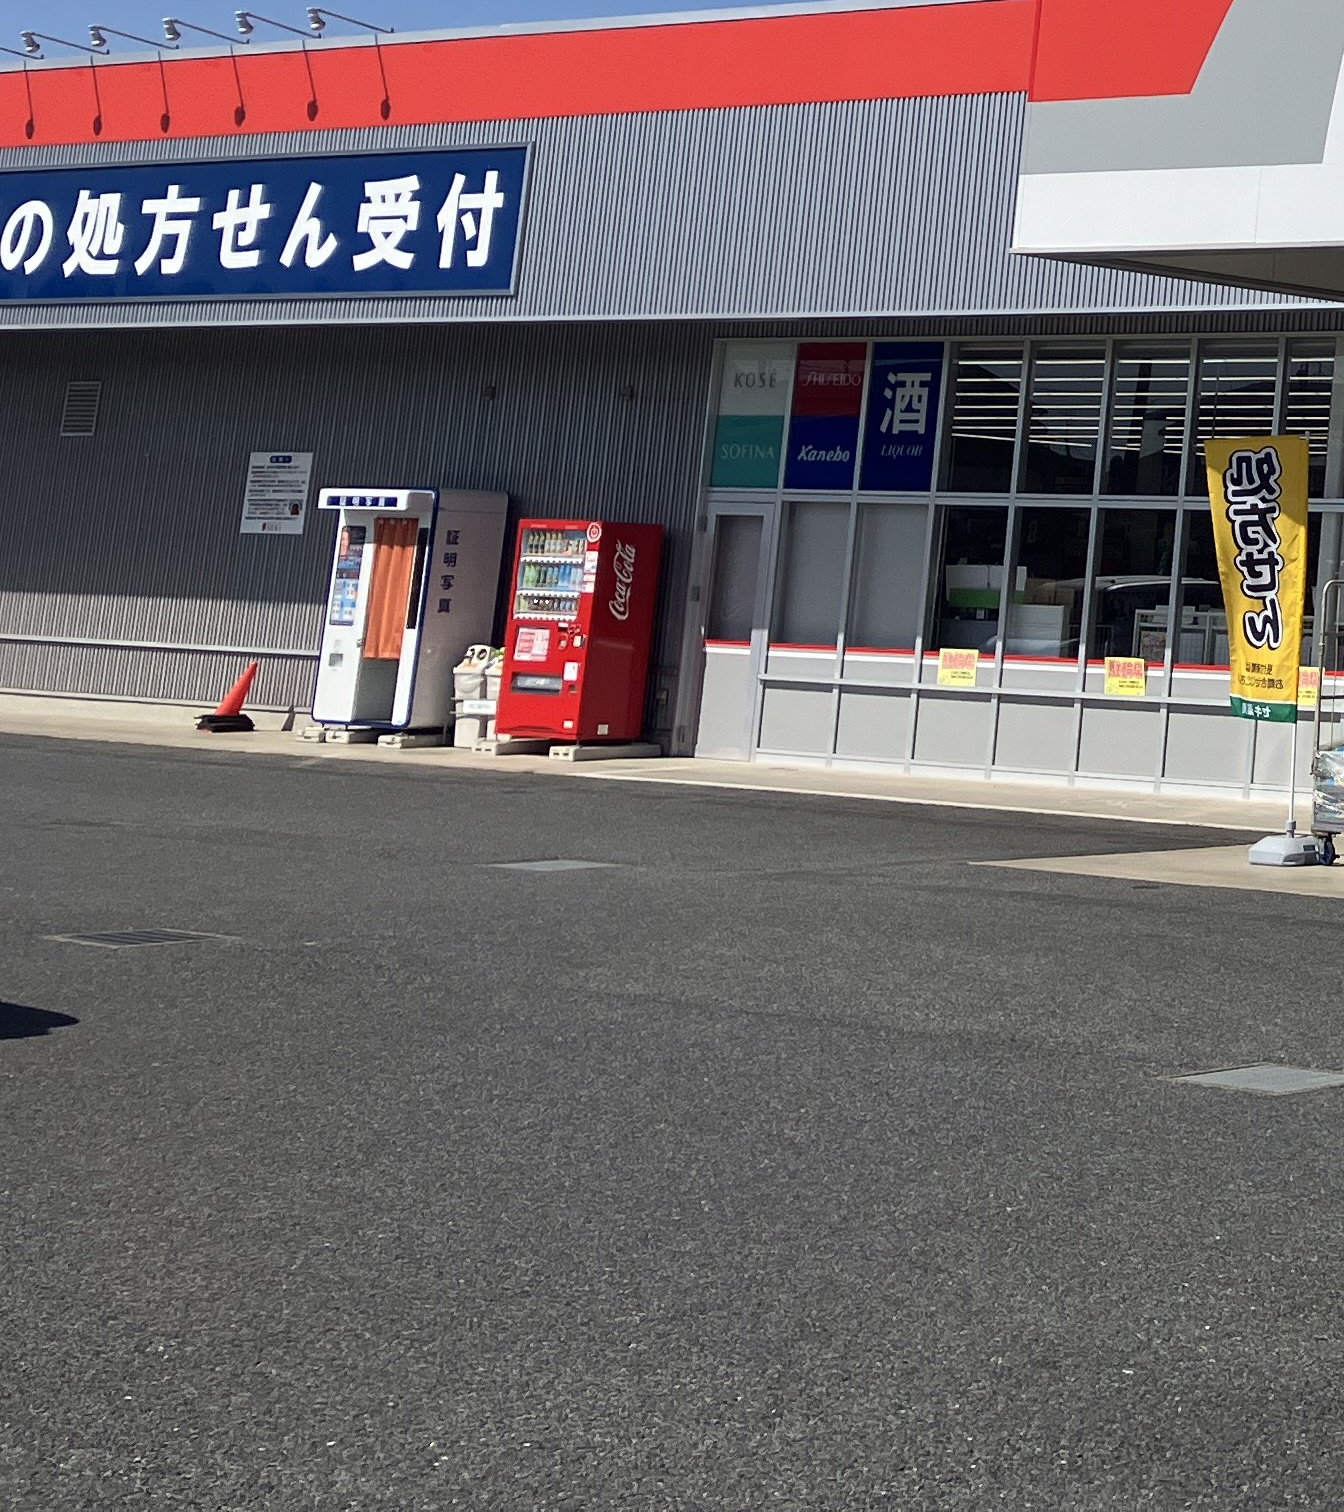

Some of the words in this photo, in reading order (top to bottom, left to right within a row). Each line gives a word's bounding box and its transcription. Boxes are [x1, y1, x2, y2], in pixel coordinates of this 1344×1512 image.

[0, 170, 505, 279] の処方せん受付
[802, 371, 862, 387] SHISEIDO
[879, 371, 932, 435] 酒
[721, 443, 774, 460] SOFINA
[797, 444, 850, 462] Kanebo
[880, 444, 923, 459] LIQUOR
